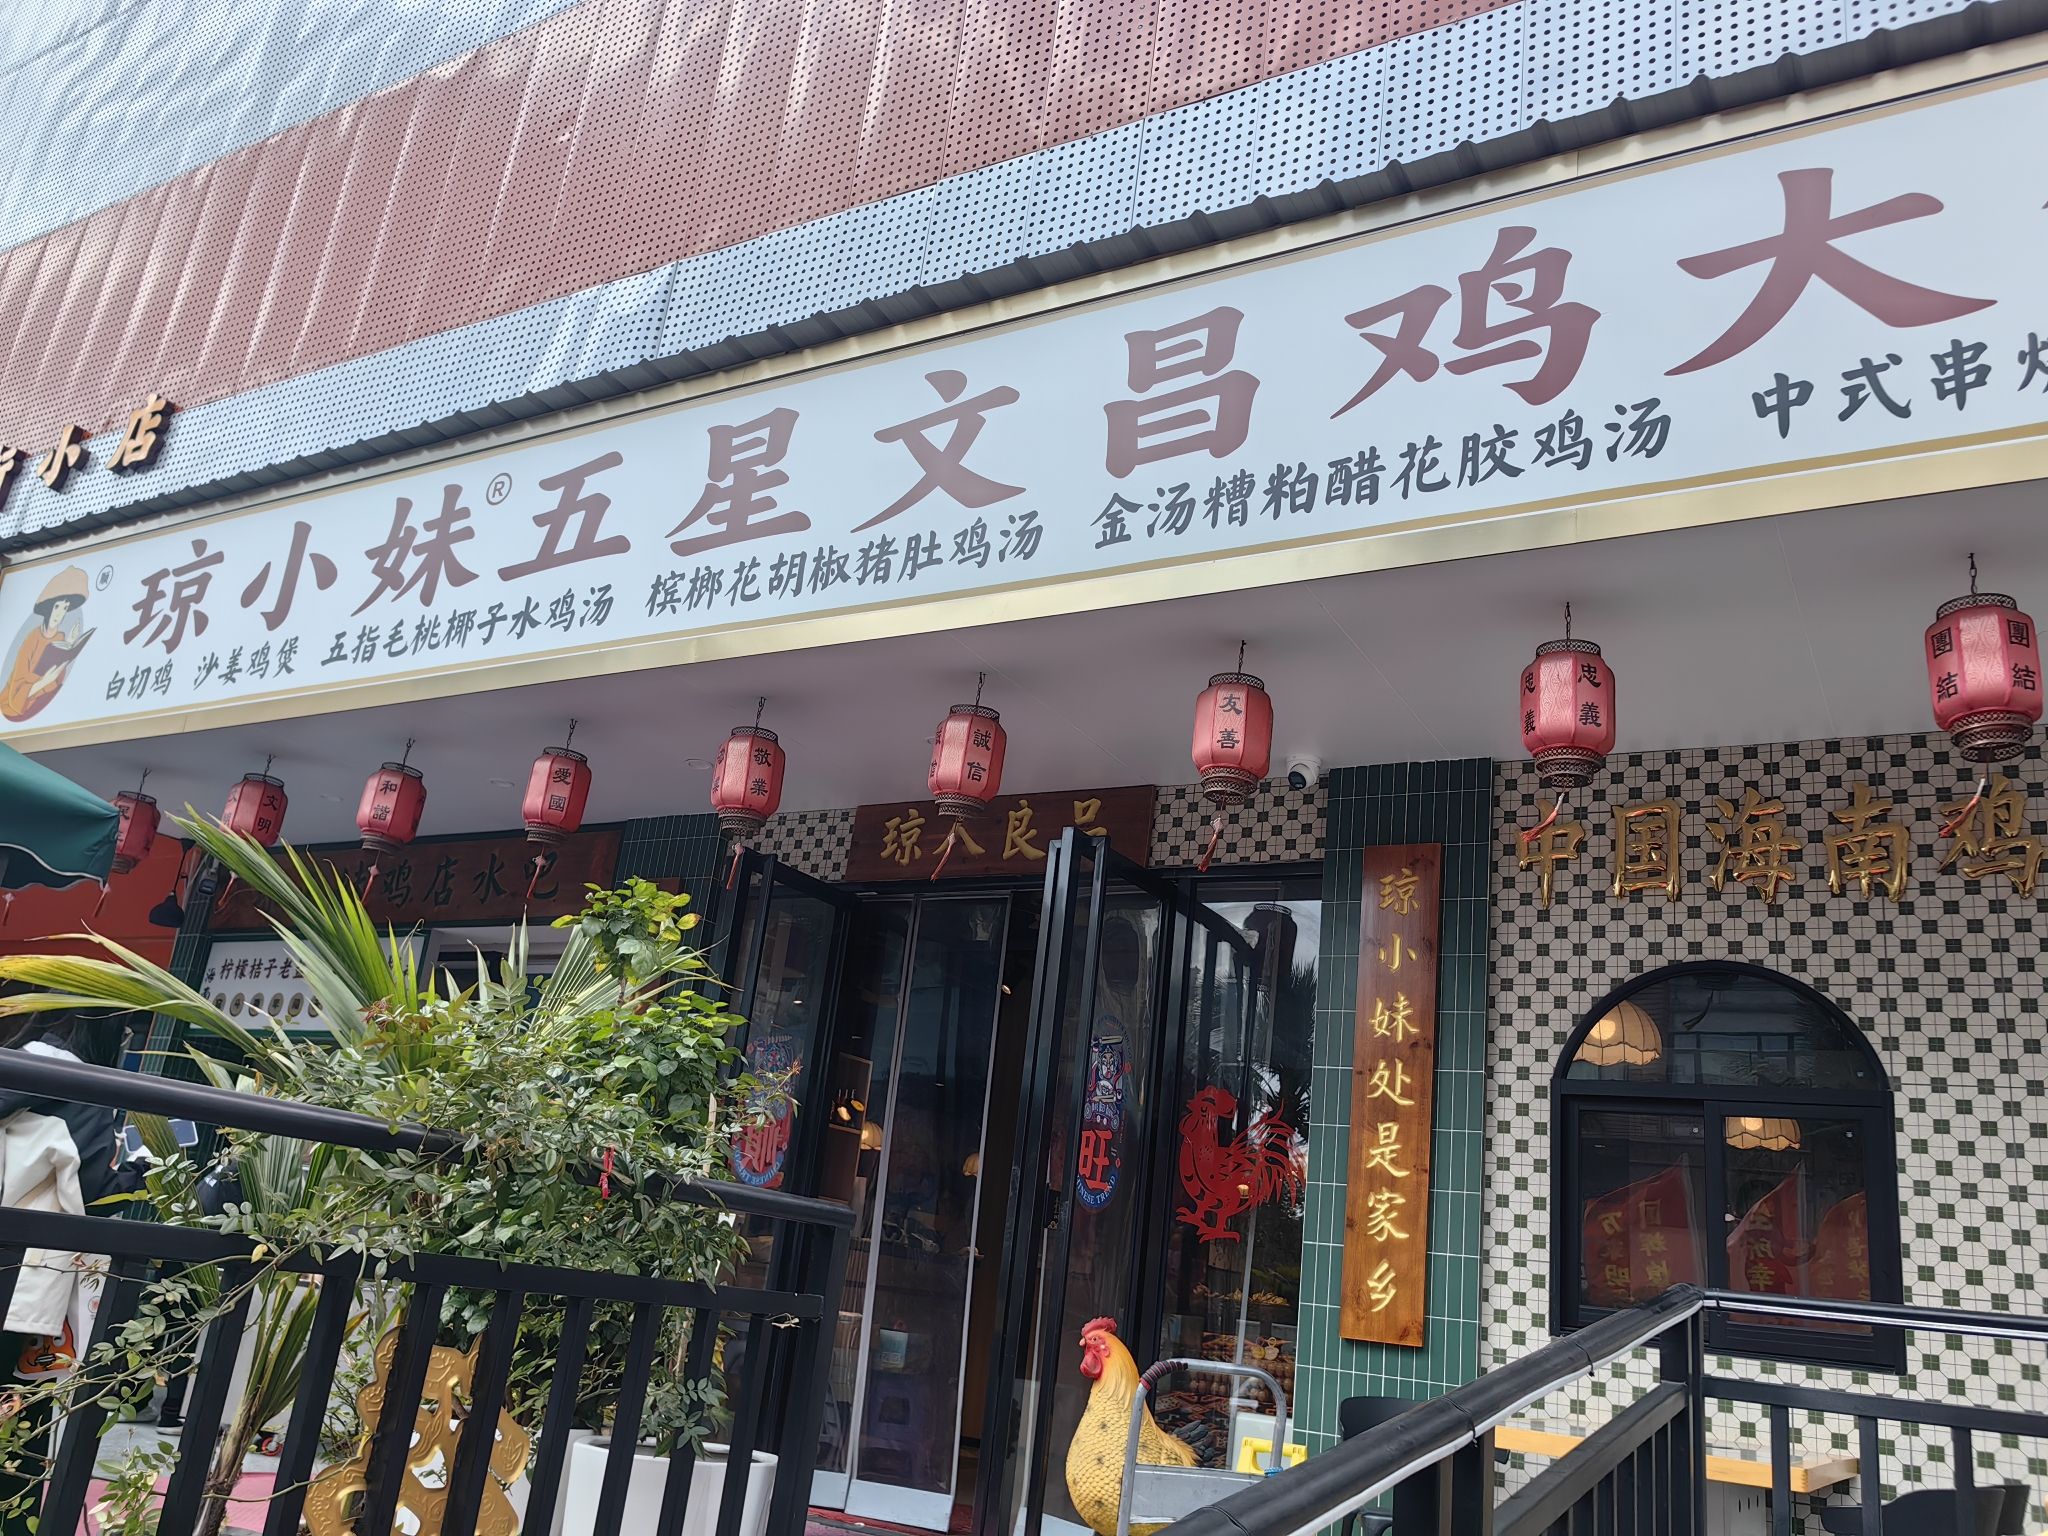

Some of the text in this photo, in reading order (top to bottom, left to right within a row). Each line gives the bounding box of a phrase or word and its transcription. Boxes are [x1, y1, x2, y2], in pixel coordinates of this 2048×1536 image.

[105, 658, 174, 701] 白切鸡
[193, 635, 299, 690] 沙姜鸡煲
[321, 584, 614, 667] 五指毛桃椰子水鸡汤
[645, 510, 1043, 617] 槟榔花胡椒猪肚鸡汤
[1090, 397, 1672, 549] 金汤糟粕醋花胶鸡汤
[1216, 693, 1243, 750] 友善
[1515, 772, 2048, 910] 中国海南鸡
[1365, 867, 1421, 1313] 琼小妹处是家乡
[1078, 1129, 1113, 1190] 旺
